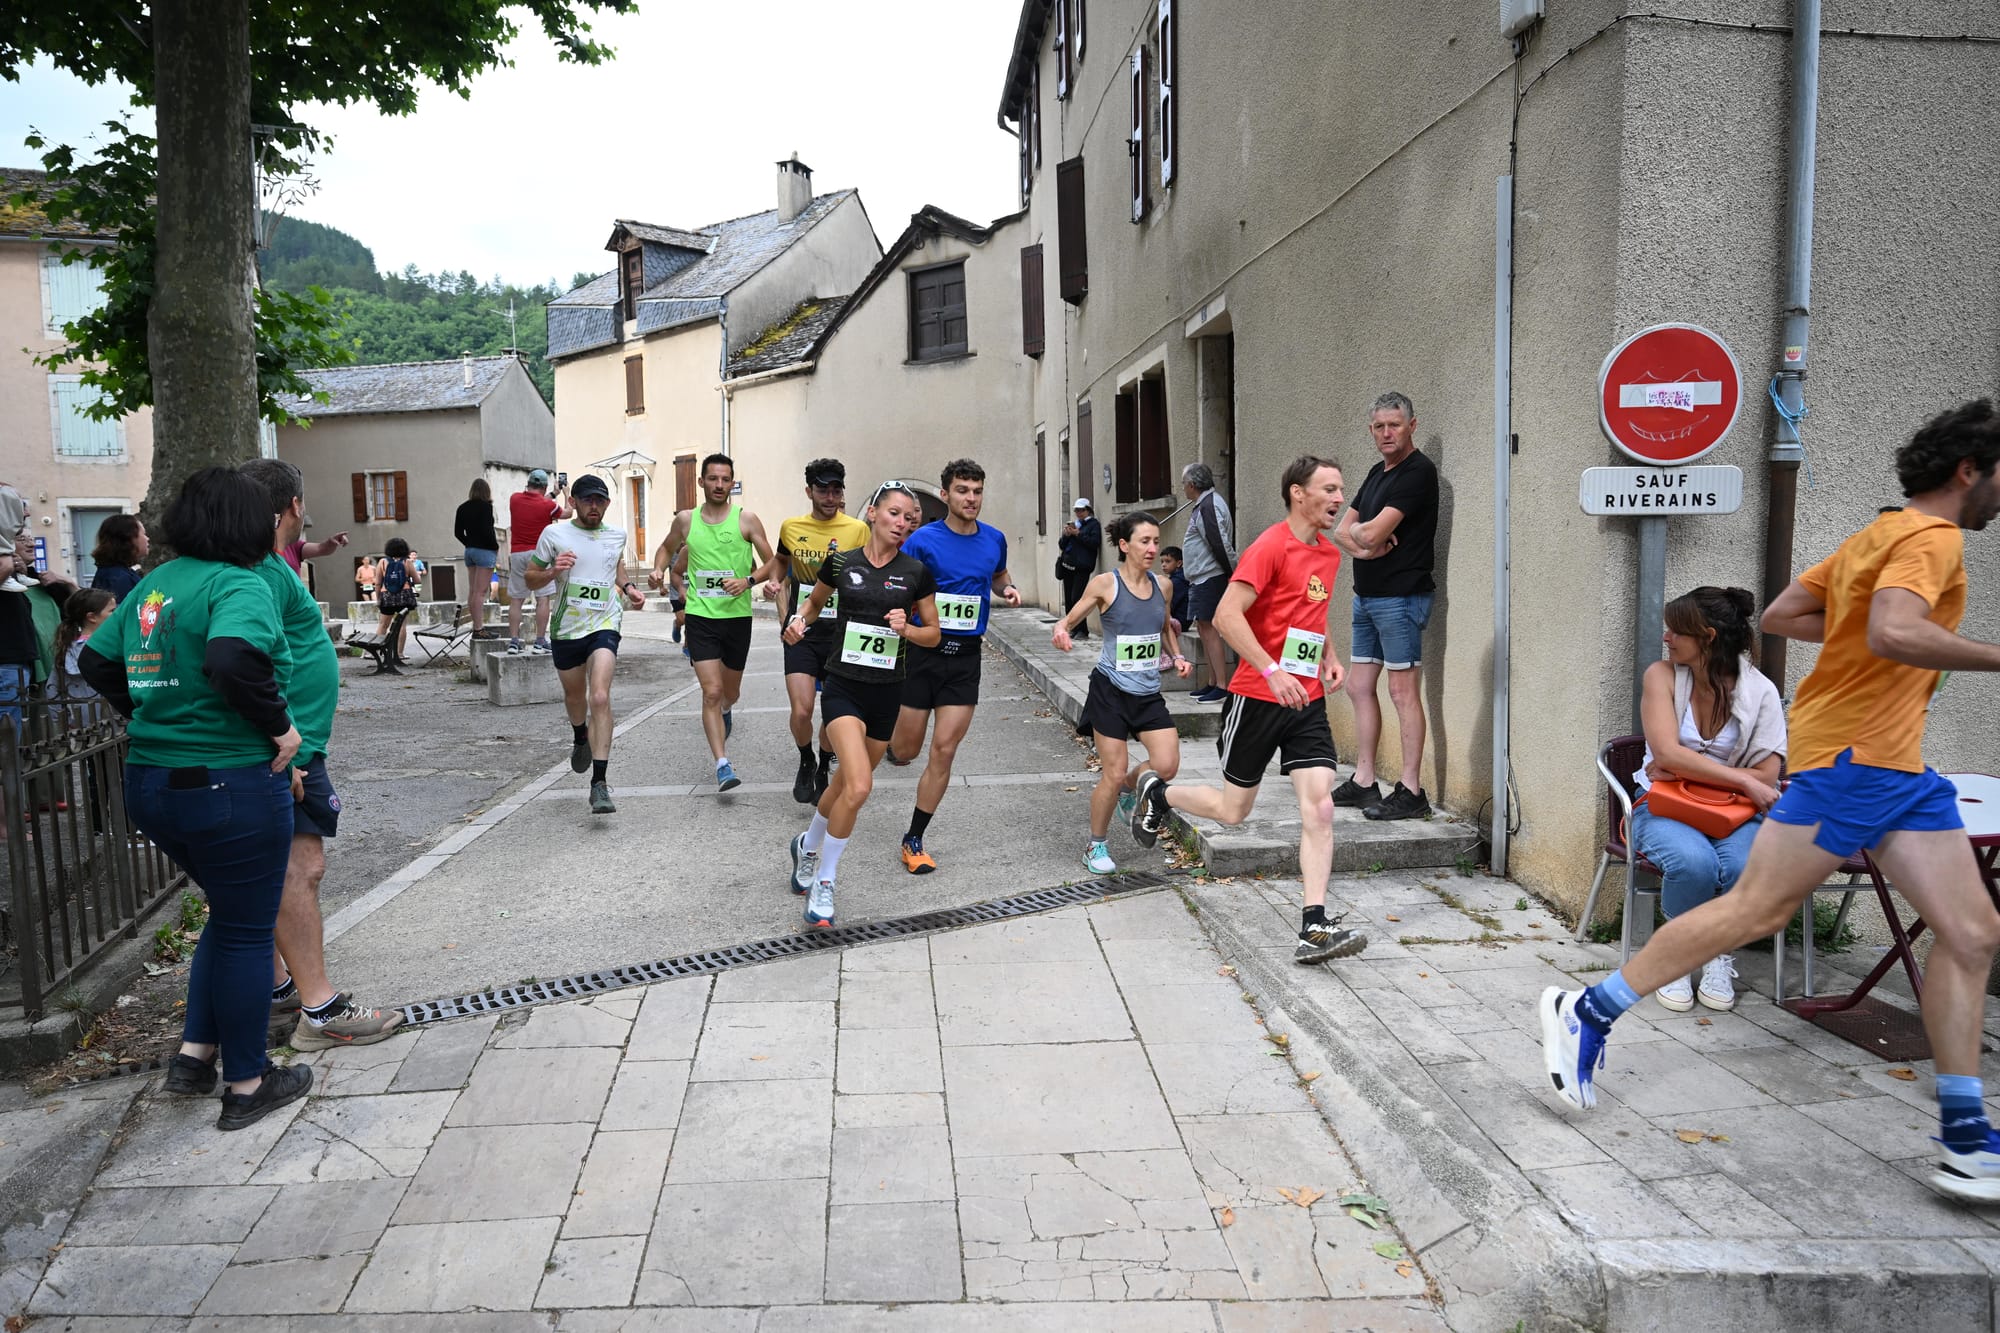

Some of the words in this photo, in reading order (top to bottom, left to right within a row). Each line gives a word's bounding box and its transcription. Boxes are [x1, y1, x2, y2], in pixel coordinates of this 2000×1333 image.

[1636, 474, 1688, 488] SAUF
[1605, 493, 1717, 507] RIVERAINS
[706, 577, 725, 589] 54
[579, 586, 601, 600] 20
[942, 603, 974, 619] 116
[860, 635, 886, 654] 78
[1124, 643, 1156, 660] 120
[1297, 642, 1317, 662] 94
[169, 678, 180, 687] 48
